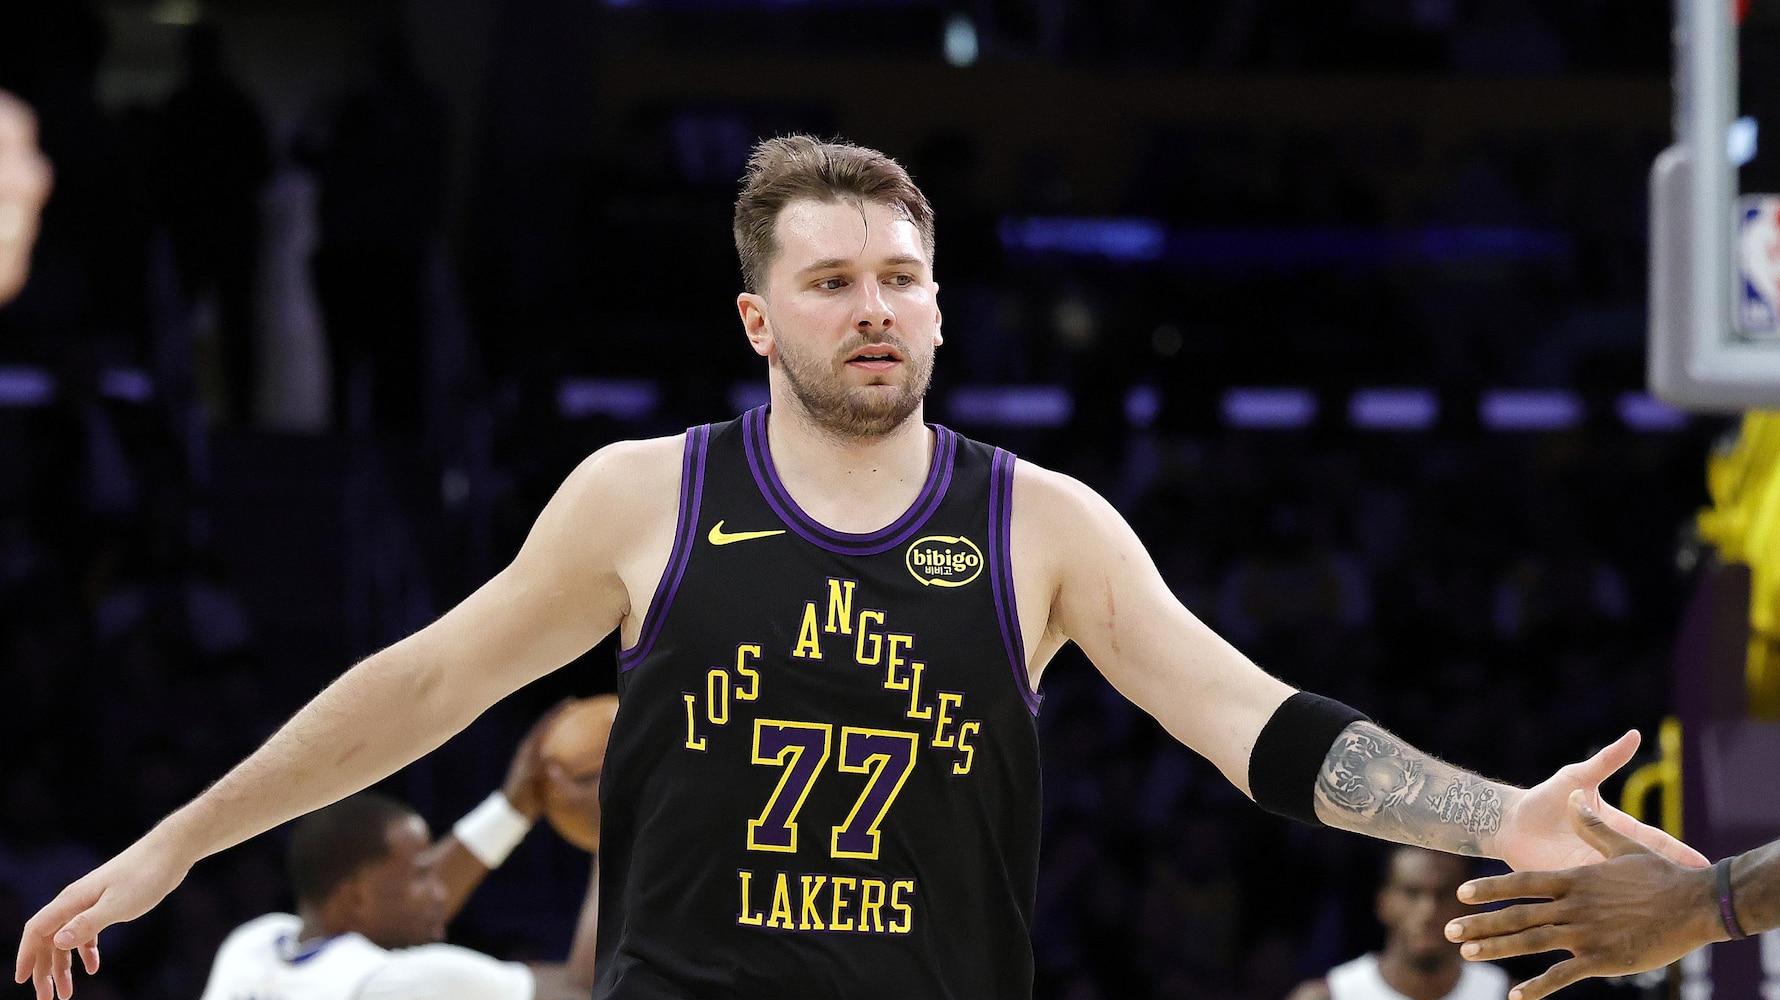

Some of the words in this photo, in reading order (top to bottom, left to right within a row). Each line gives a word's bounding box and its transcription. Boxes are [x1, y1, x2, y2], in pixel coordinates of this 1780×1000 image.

[913, 548, 979, 572] bibigo
[925, 565, 953, 576] 비비고
[683, 643, 763, 752] LOS
[792, 577, 981, 776] ANGELES
[746, 717, 920, 861] 77
[737, 870, 915, 934] LAKERS
